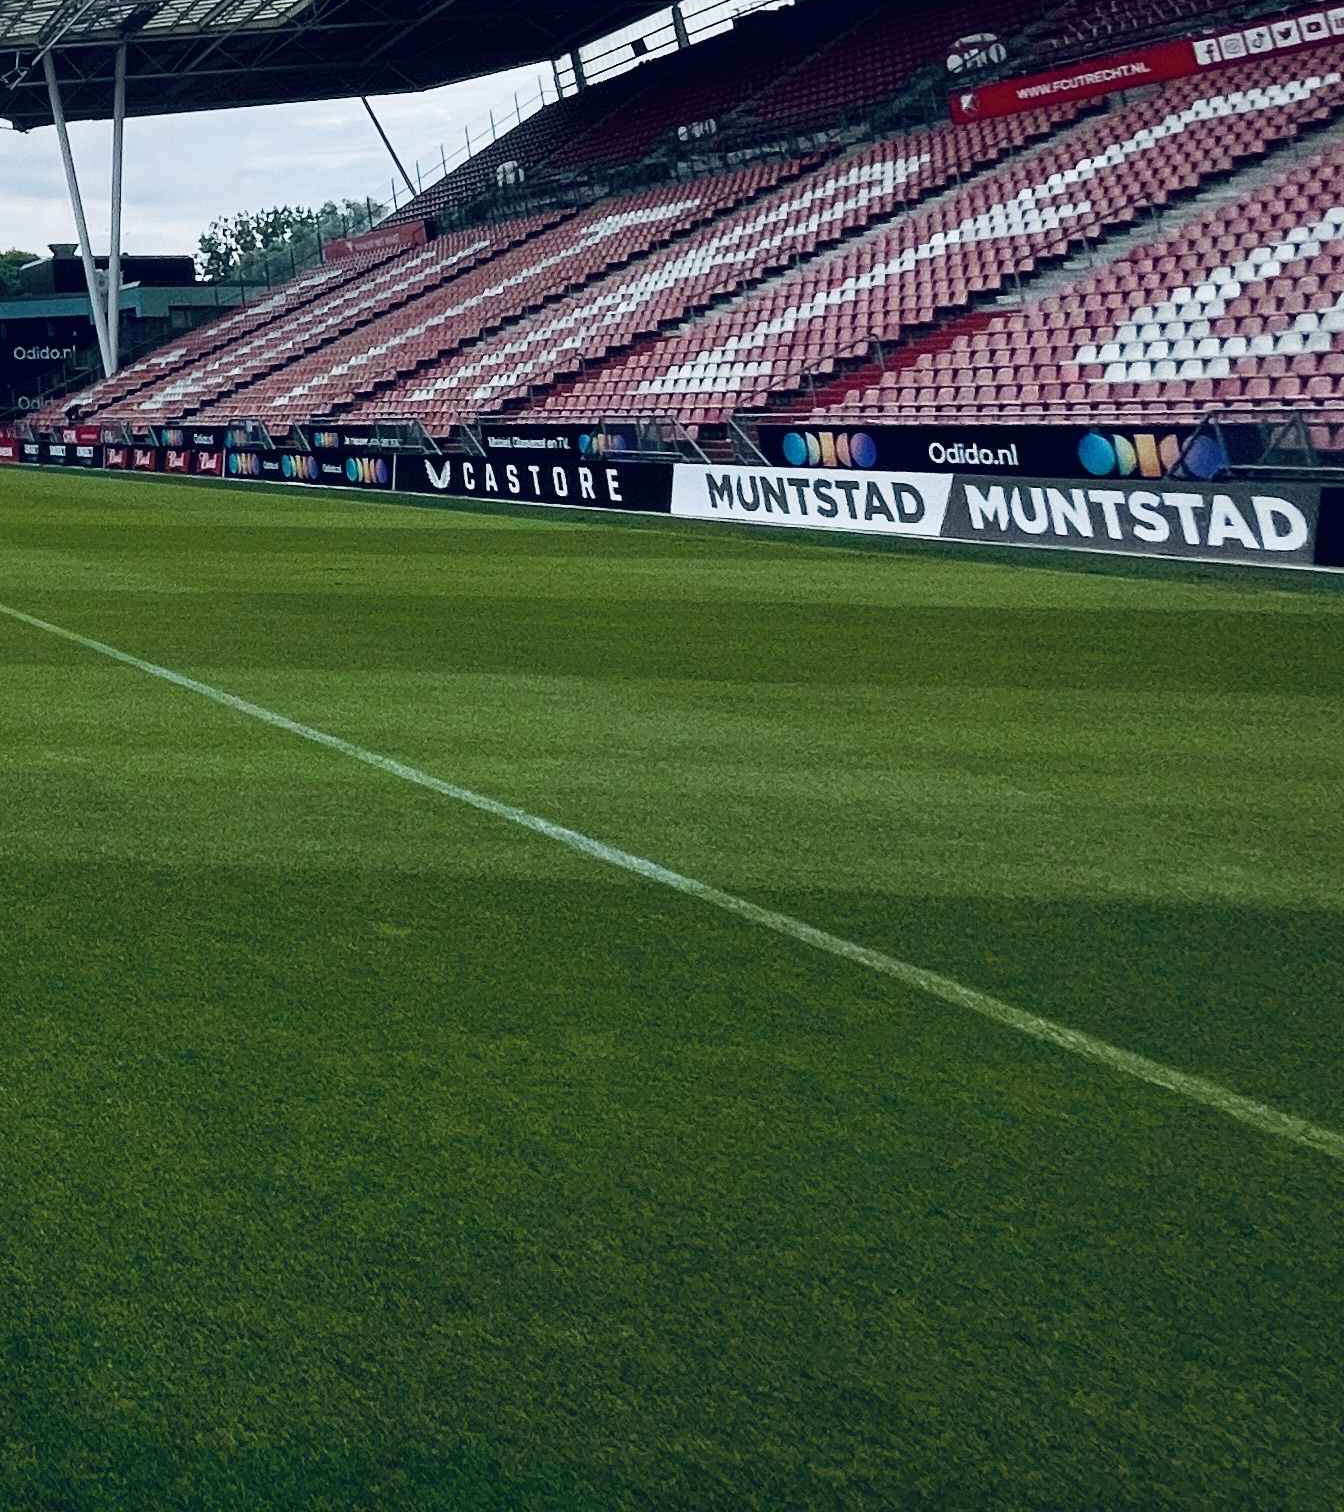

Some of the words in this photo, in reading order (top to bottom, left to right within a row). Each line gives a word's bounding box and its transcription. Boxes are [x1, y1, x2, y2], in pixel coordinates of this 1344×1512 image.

[1016, 62, 1152, 99] WWW.FCUTRECHT.NL
[927, 442, 1019, 466] Odido.nl
[463, 461, 623, 501] CASTORE
[705, 473, 926, 524] MUNTSTAD
[963, 484, 1308, 551] MUNTSTAD
